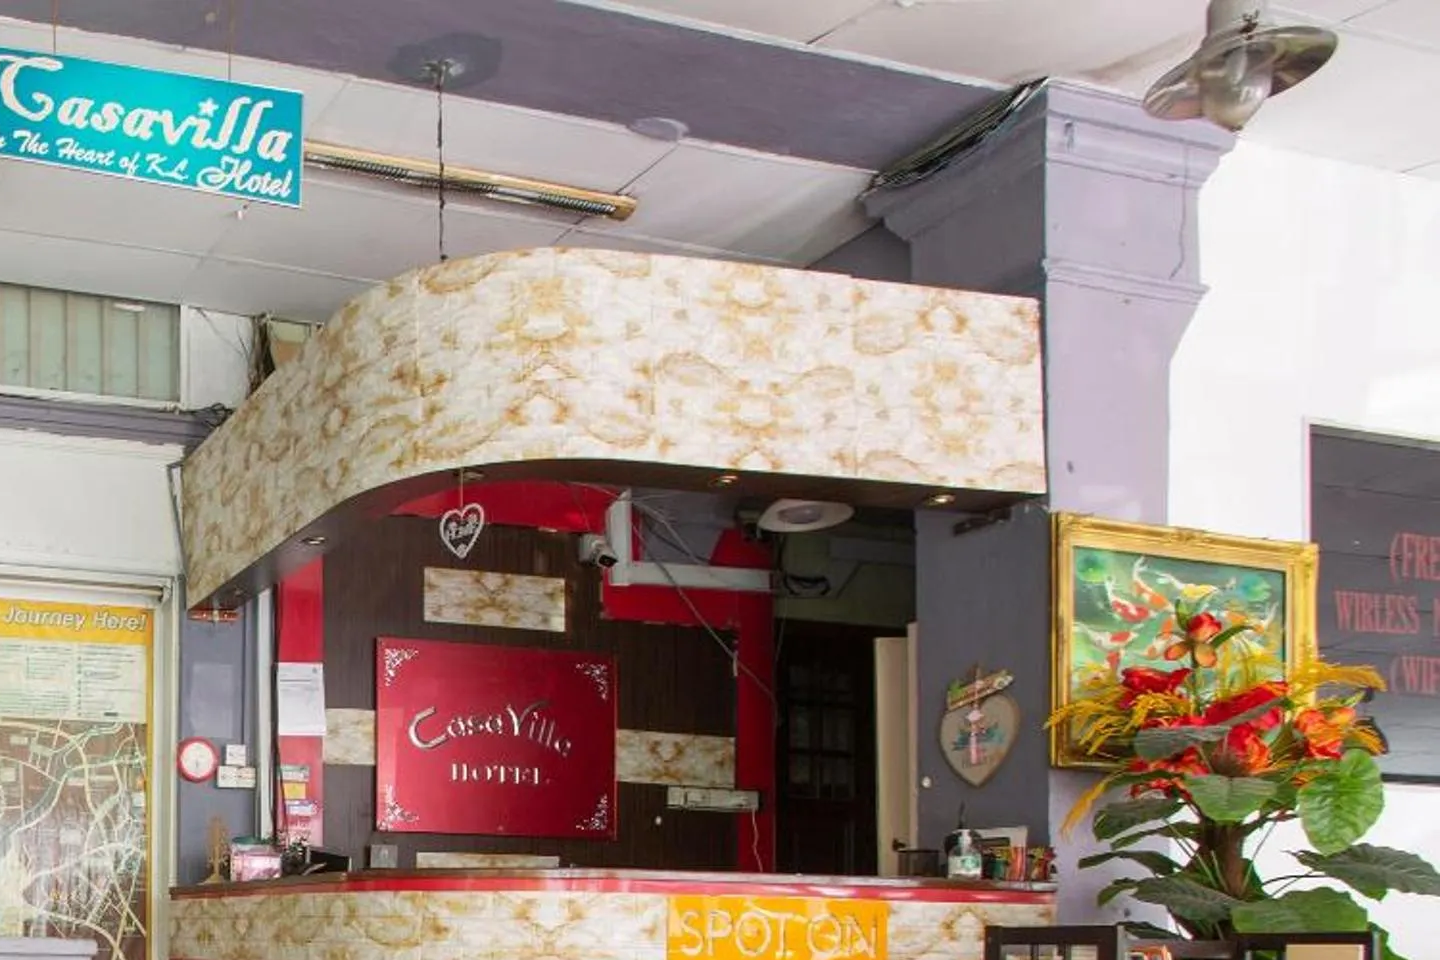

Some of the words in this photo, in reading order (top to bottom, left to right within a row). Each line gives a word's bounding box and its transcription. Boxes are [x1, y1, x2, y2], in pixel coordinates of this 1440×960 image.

[13, 129, 49, 155] The
[55, 137, 115, 167] Heart
[118, 151, 140, 176] of
[196, 155, 293, 197] Hotel
[3, 607, 86, 631] Journey
[92, 611, 147, 633] Here!
[449, 762, 551, 786] HOTEL
[680, 909, 795, 960] SPOT
[806, 912, 879, 959] ON
